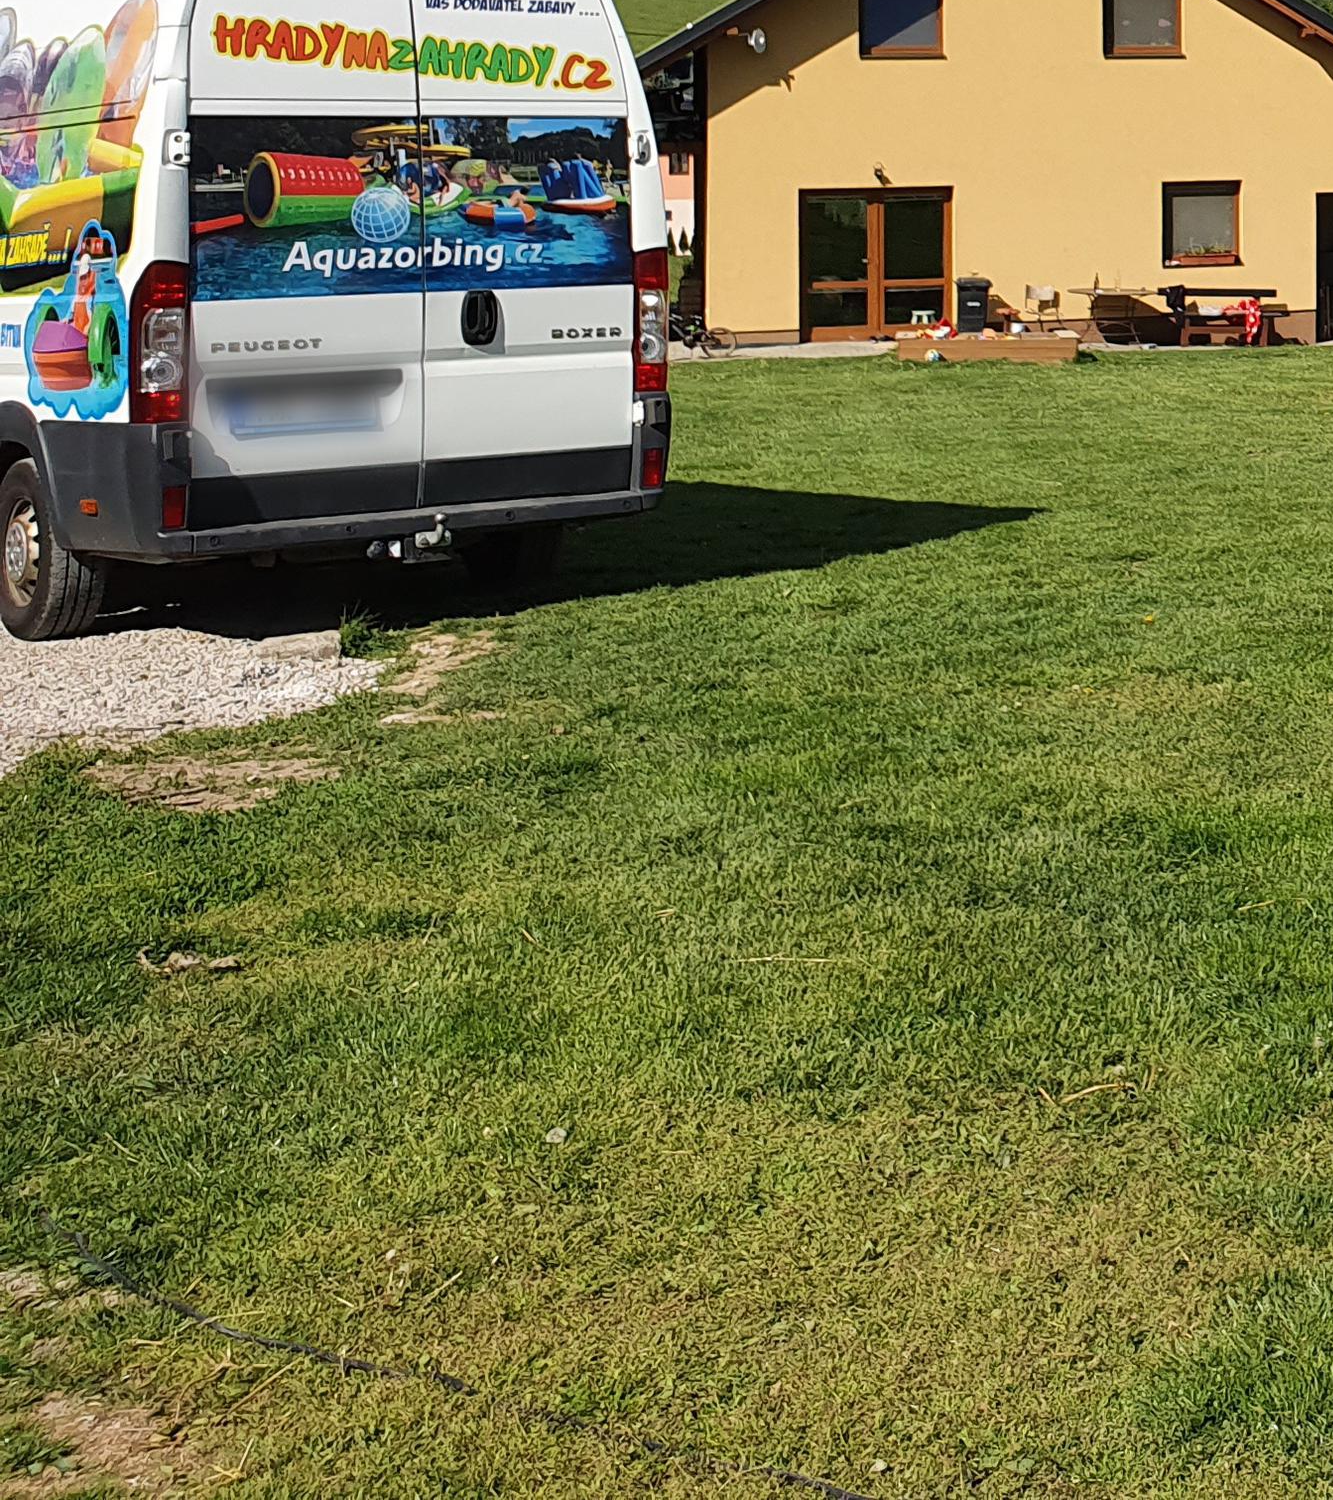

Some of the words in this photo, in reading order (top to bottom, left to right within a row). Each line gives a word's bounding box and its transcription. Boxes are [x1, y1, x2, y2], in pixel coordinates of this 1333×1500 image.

[282, 237, 545, 278] Aquazorbing.cz
[551, 327, 622, 340] BOXER
[211, 338, 323, 354] PEUGEOT
